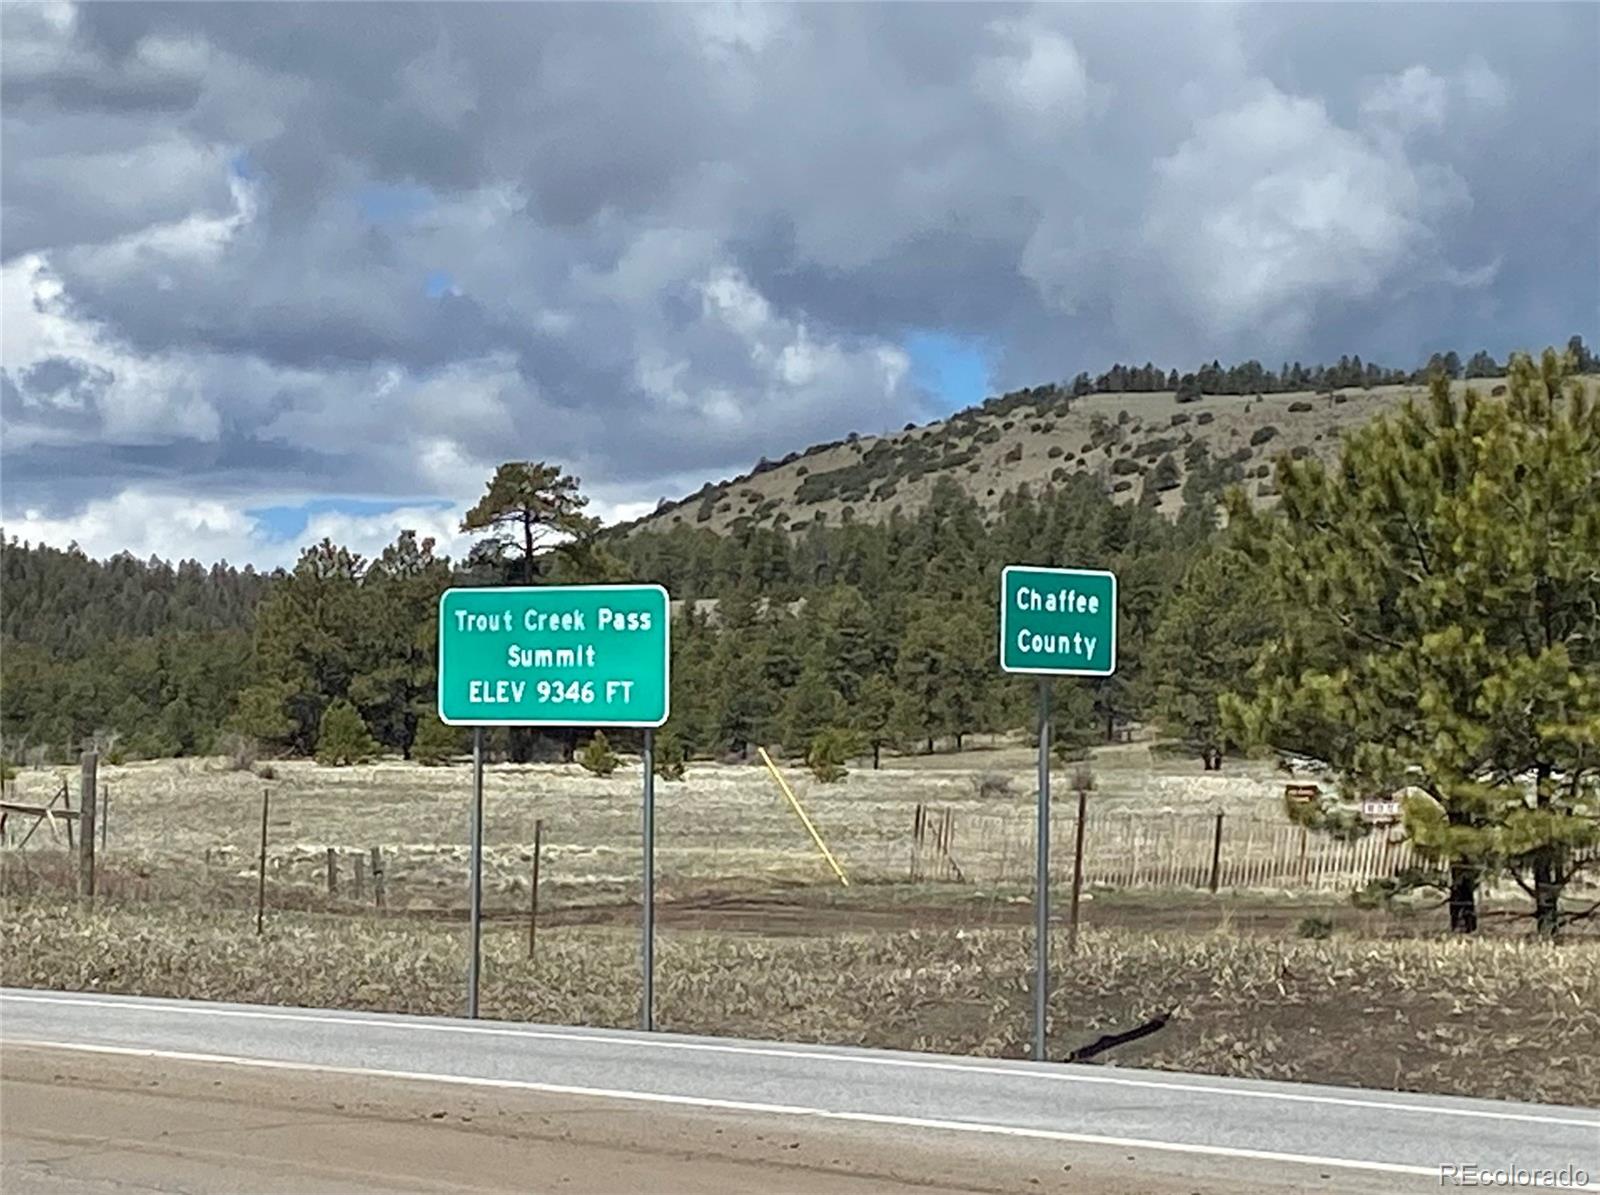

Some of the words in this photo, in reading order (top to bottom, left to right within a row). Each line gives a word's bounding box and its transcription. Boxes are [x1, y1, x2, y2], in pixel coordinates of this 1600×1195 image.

[1016, 586, 1099, 614] Chaffee
[455, 609, 513, 631] Trout
[524, 608, 585, 631] Creek
[598, 608, 651, 631] Pass
[508, 644, 596, 667] Summit
[1017, 628, 1097, 661] County
[469, 680, 526, 703] ELEV
[536, 680, 595, 704] 9346
[606, 680, 634, 704] FT
